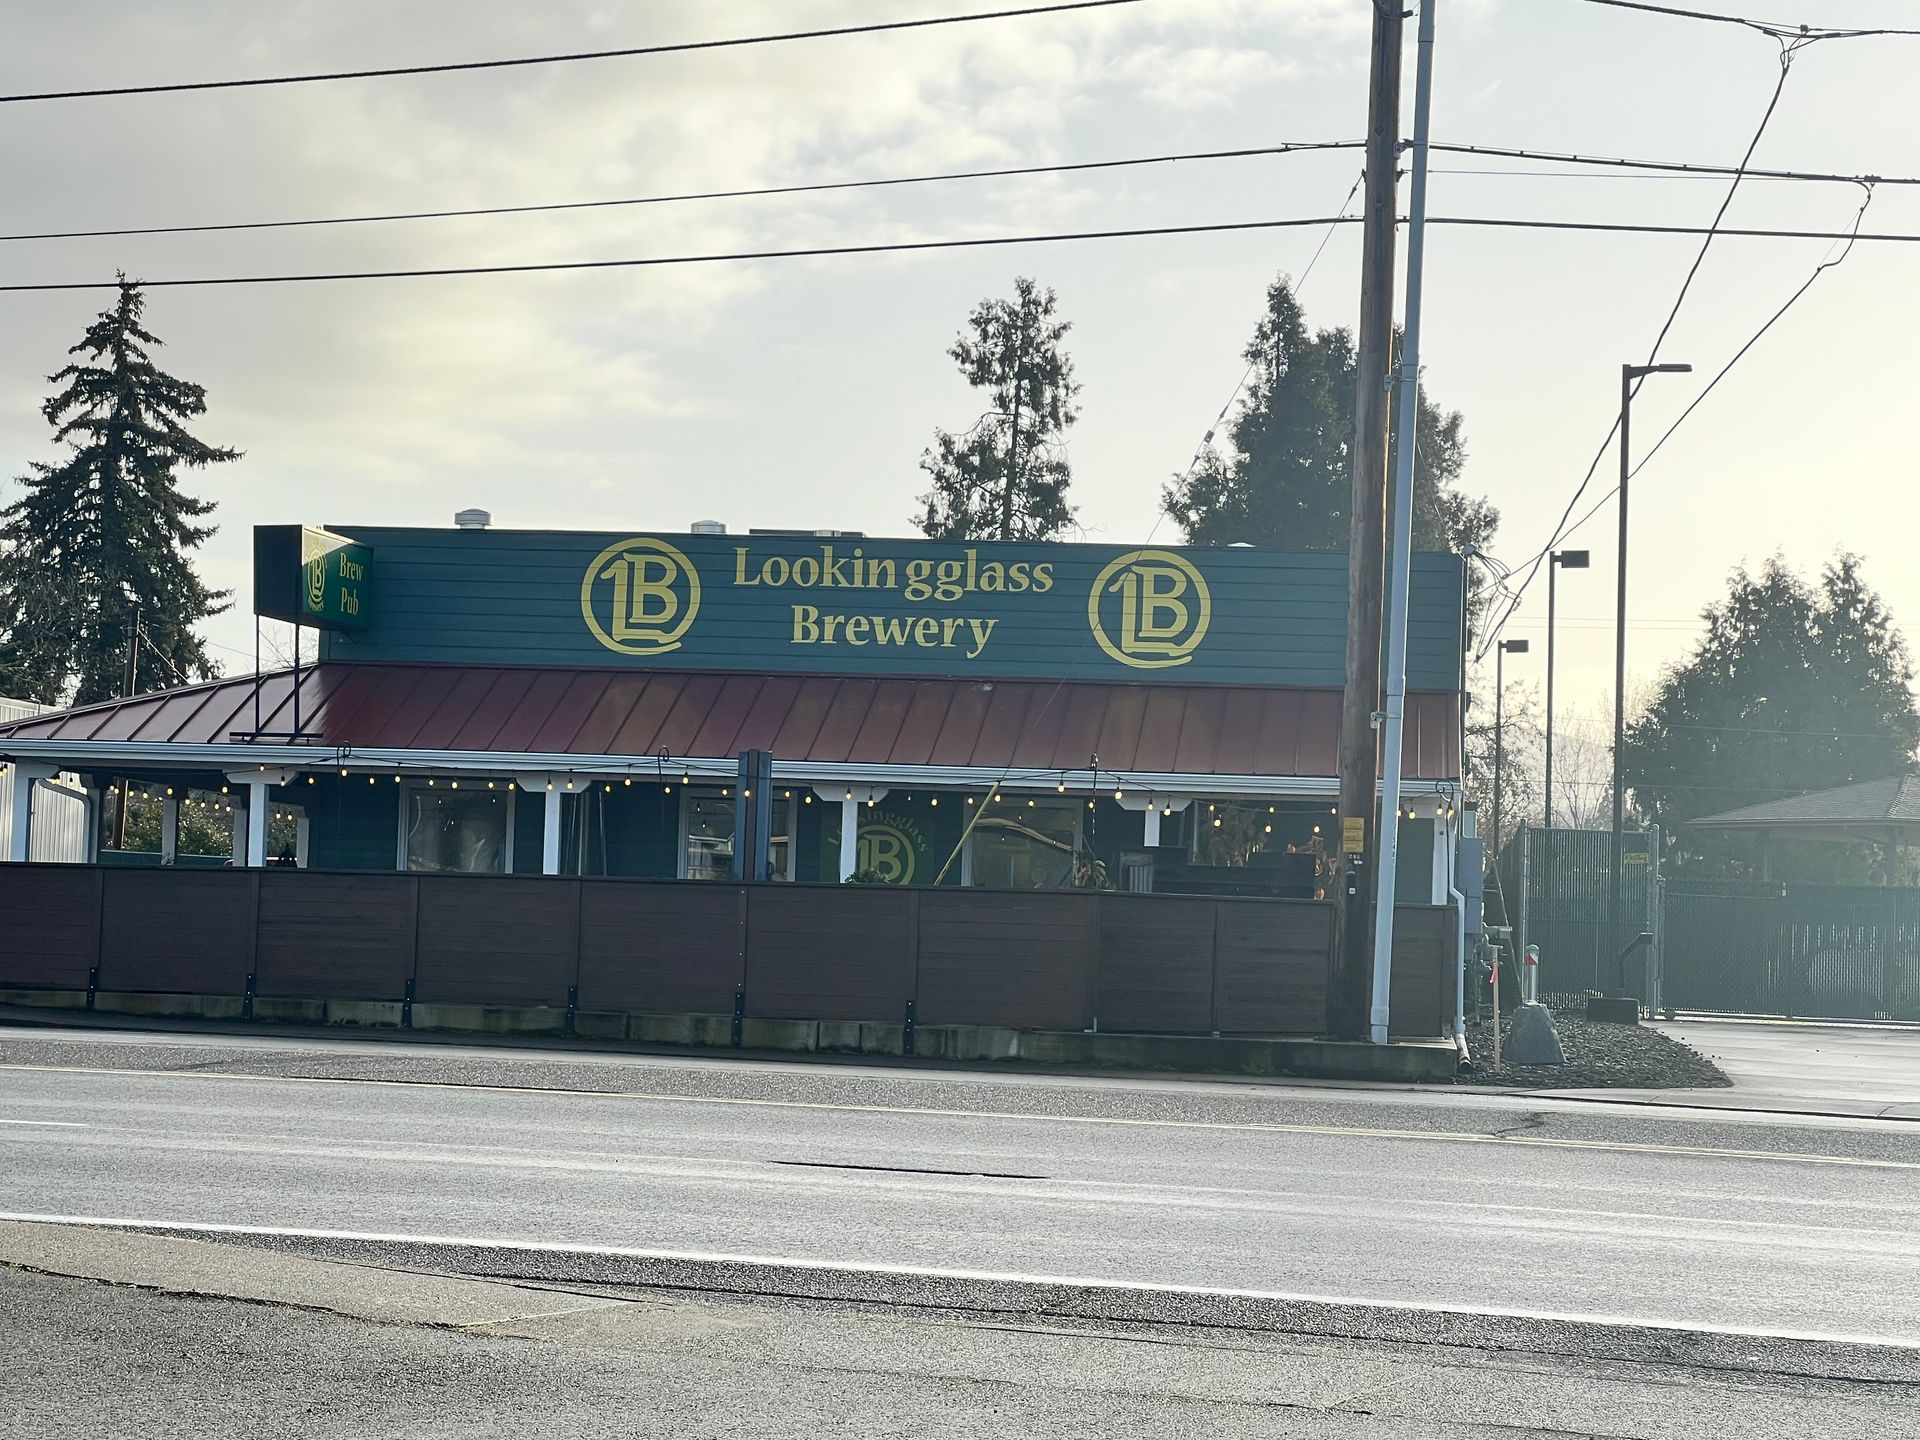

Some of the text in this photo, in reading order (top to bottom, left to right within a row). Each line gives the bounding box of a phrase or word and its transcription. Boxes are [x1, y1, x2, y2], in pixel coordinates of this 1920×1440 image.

[340, 553, 363, 581] Brew
[733, 545, 1053, 601] Lookingglass
[341, 587, 359, 615] Pub
[790, 605, 999, 659] Brewery
[827, 810, 928, 852] Lingglass
